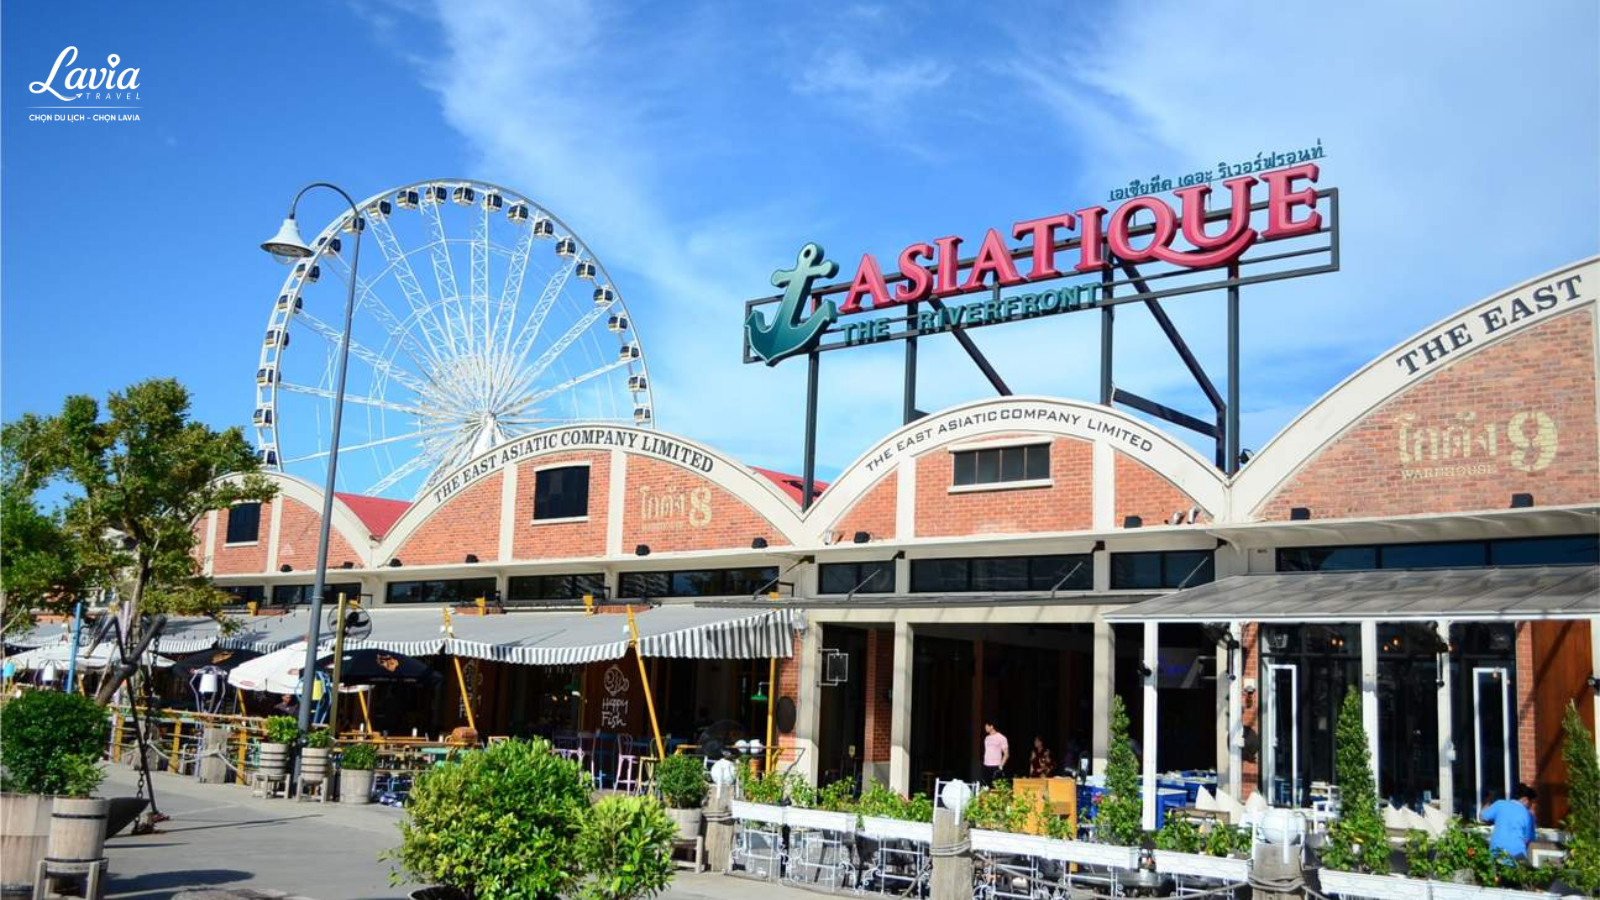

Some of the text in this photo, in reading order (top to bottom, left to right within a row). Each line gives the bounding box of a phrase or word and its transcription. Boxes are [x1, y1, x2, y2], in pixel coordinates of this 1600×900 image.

[838, 163, 1323, 314] ASIATIQUE
[841, 283, 1102, 345] THE RIVERFRONT
[1396, 274, 1582, 376] THE EAST
[434, 429, 714, 503] THE EAST ASIATIC COMPANY LIMITED
[865, 408, 1153, 472] THE EAST ASIATIC COMPANY LIMITED
[1507, 411, 1558, 472] 9
[1401, 464, 1498, 480] WAREHOUSE
[689, 486, 713, 528] 8
